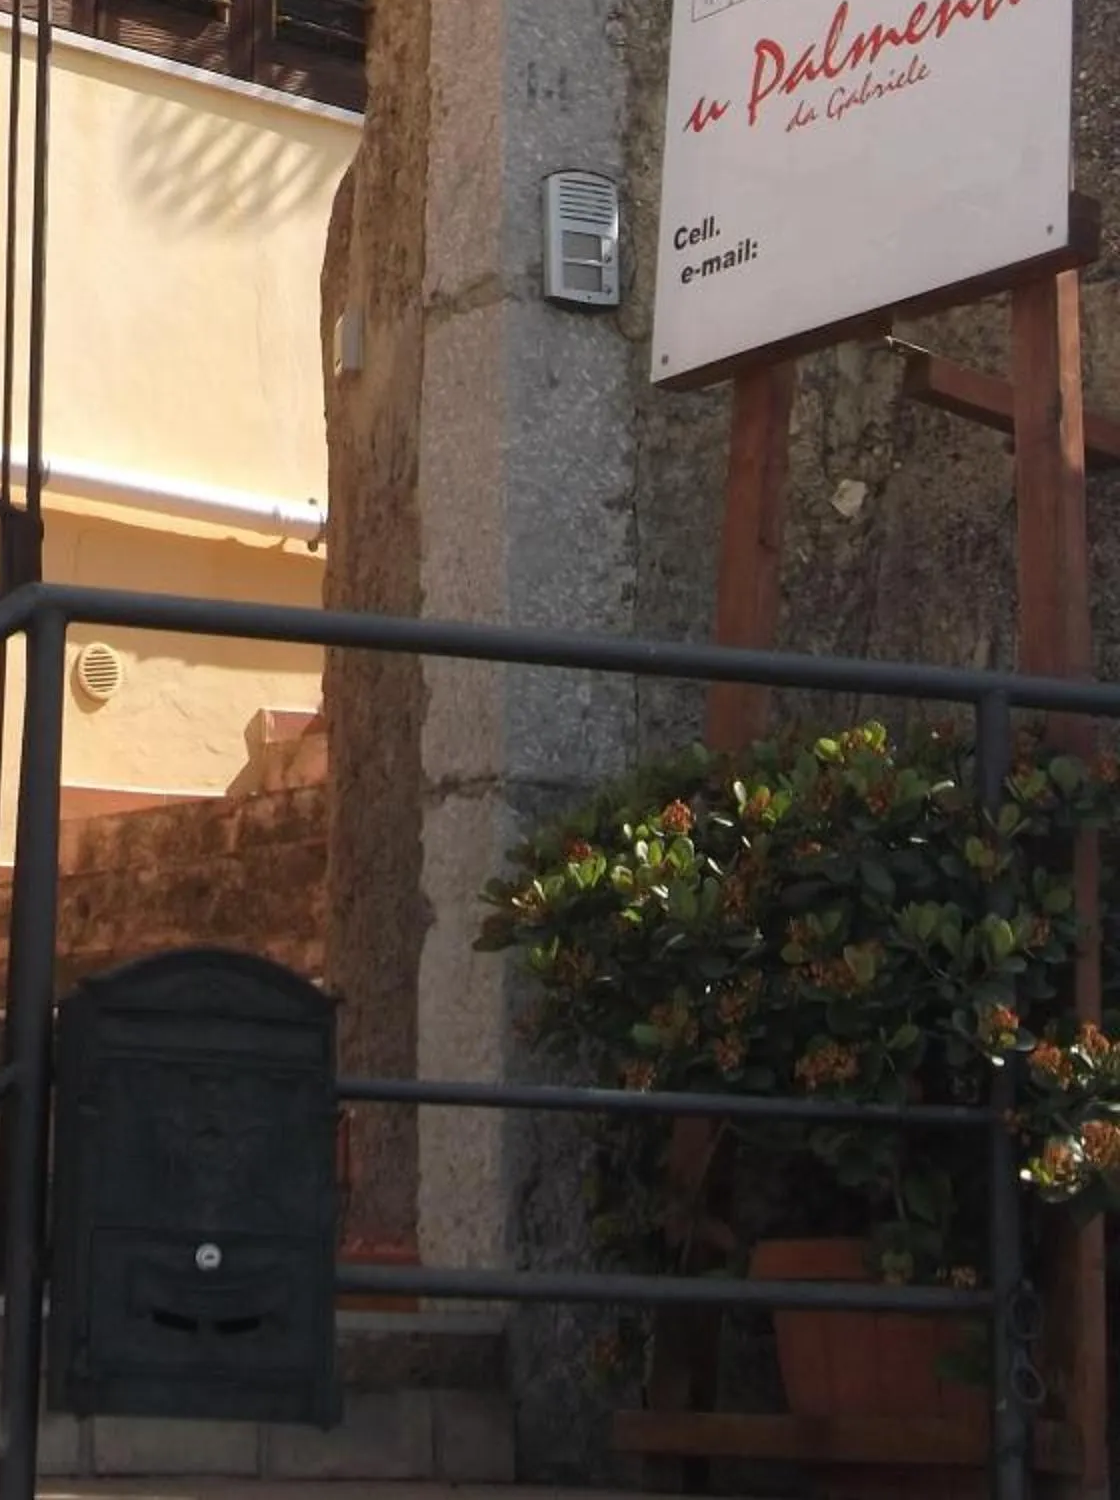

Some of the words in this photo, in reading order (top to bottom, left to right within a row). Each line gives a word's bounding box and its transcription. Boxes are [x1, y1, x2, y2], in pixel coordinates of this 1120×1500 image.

[785, 101, 819, 133] da
[826, 53, 931, 120] Gabriele
[683, 96, 731, 134] u
[673, 215, 721, 250] Cell.
[681, 238, 759, 285] e-mail:
